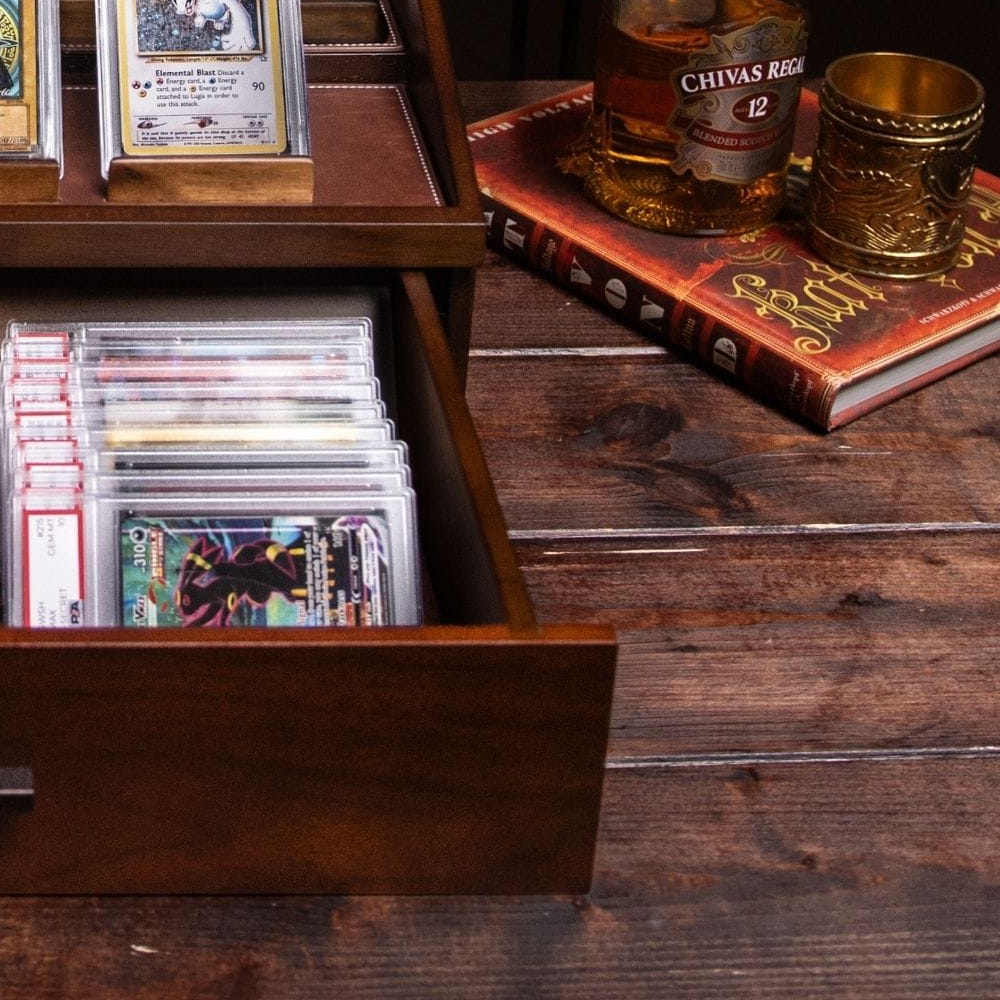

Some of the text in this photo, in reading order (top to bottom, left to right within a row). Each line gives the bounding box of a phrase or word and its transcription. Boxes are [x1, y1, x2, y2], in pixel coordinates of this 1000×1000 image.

[155, 69, 194, 77] Elemental
[681, 64, 763, 93] CHIVAS
[198, 85, 218, 93] Energy
[251, 81, 265, 91] 90
[518, 92, 594, 122] VOLTAG
[747, 96, 769, 118] 12
[692, 128, 739, 147] BLENDED
[47, 518, 55, 556] GEM MT
[134, 544, 146, 567] 310
[71, 601, 80, 624] PSA
